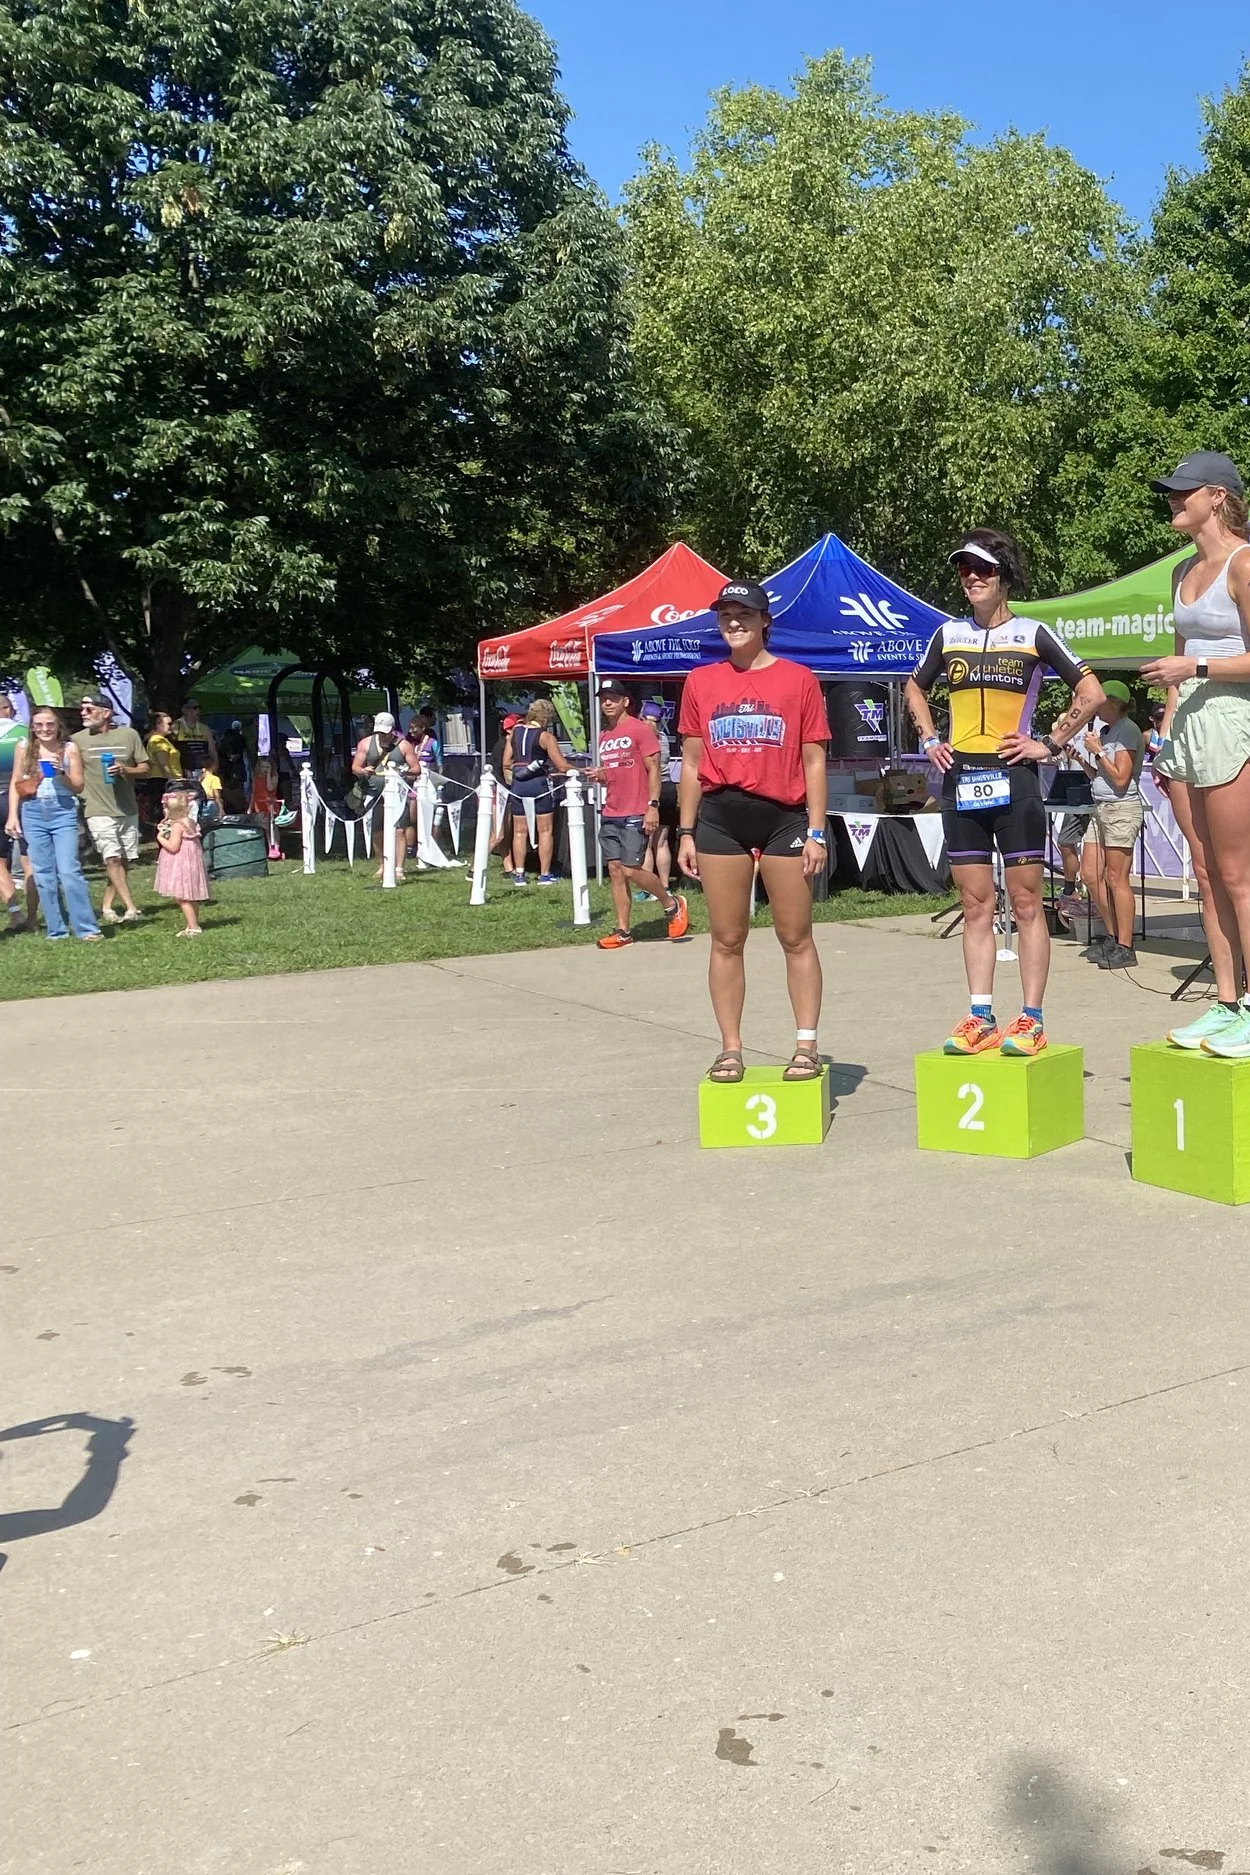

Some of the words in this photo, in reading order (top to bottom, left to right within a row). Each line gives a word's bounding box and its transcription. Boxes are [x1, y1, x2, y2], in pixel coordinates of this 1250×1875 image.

[877, 640, 923, 653] ABOVE
[877, 653, 906, 661] EVENTS
[998, 657, 1024, 668] team
[970, 664, 1023, 677] Athletic
[969, 672, 1024, 686] Mentors
[973, 784, 994, 798] 80
[957, 1083, 985, 1131] 2
[746, 1094, 777, 1139] 3
[1174, 1098, 1185, 1151] 1
